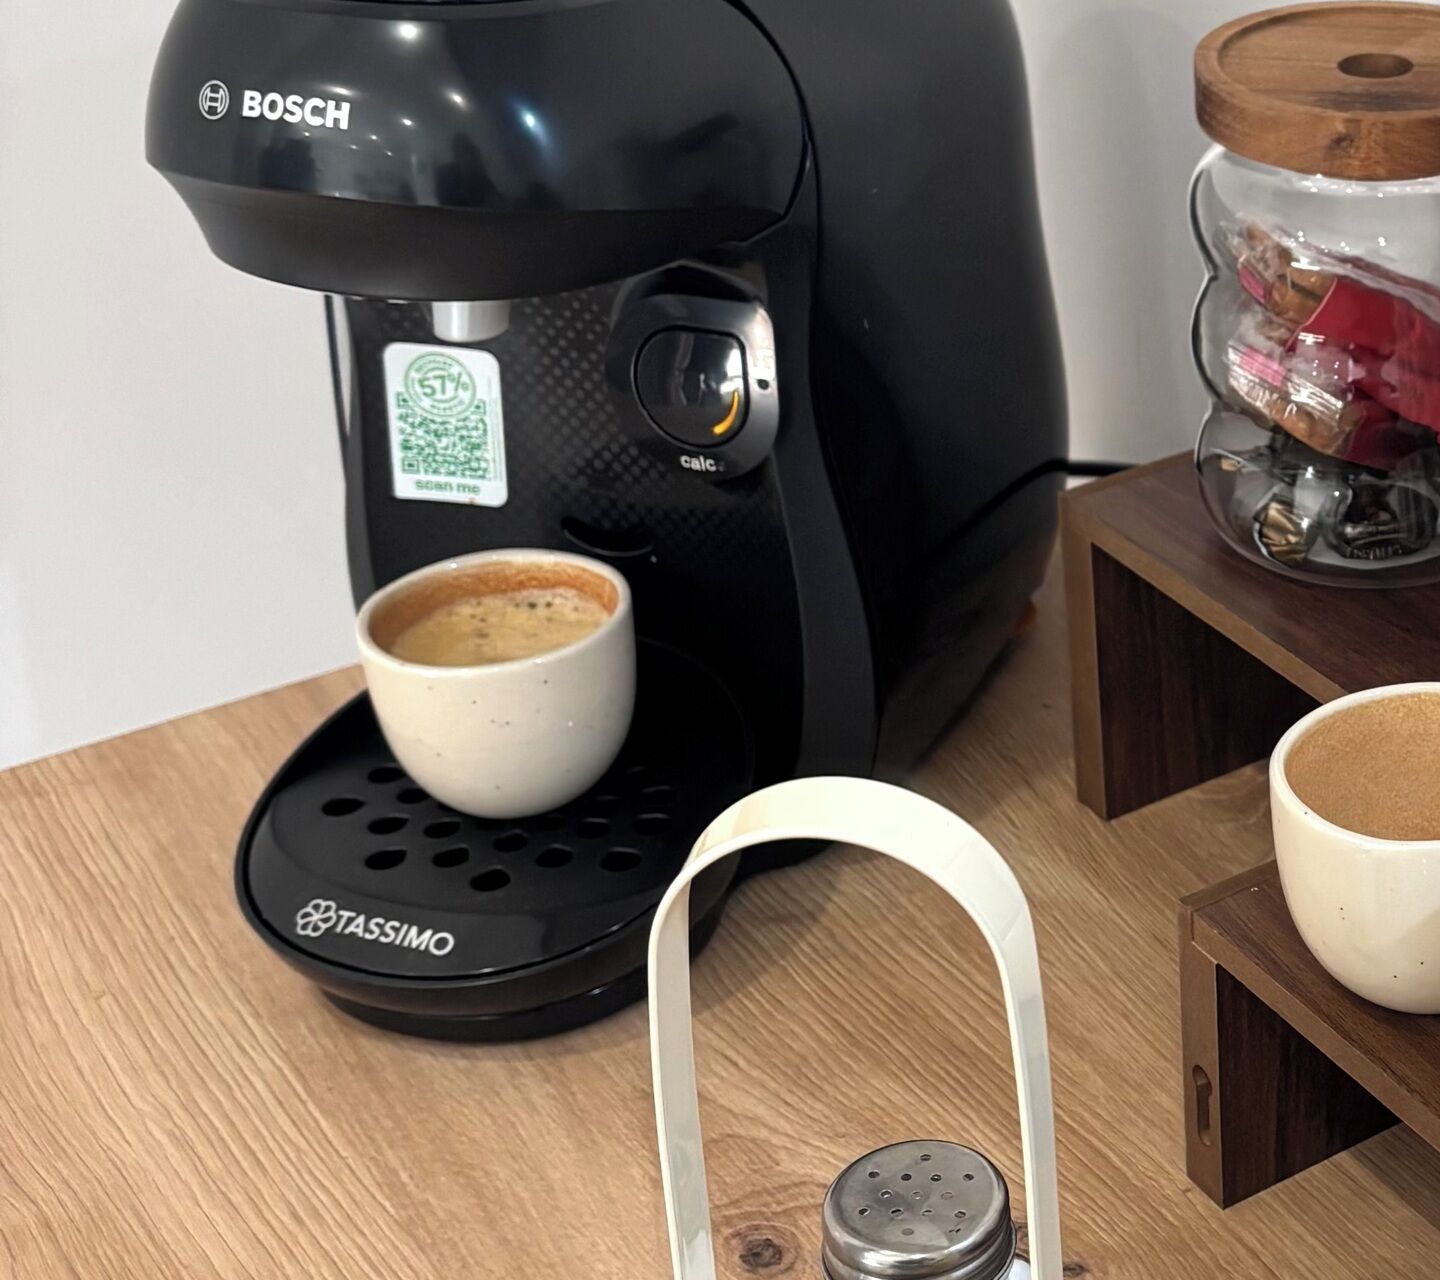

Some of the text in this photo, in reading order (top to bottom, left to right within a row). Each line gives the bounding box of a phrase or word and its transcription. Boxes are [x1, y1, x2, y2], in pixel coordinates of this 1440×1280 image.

[242, 89, 351, 130] BOSCH
[417, 370, 470, 397] 57%
[680, 454, 717, 472] calc
[415, 479, 481, 495] scan me
[335, 909, 455, 956] TASSIMO
